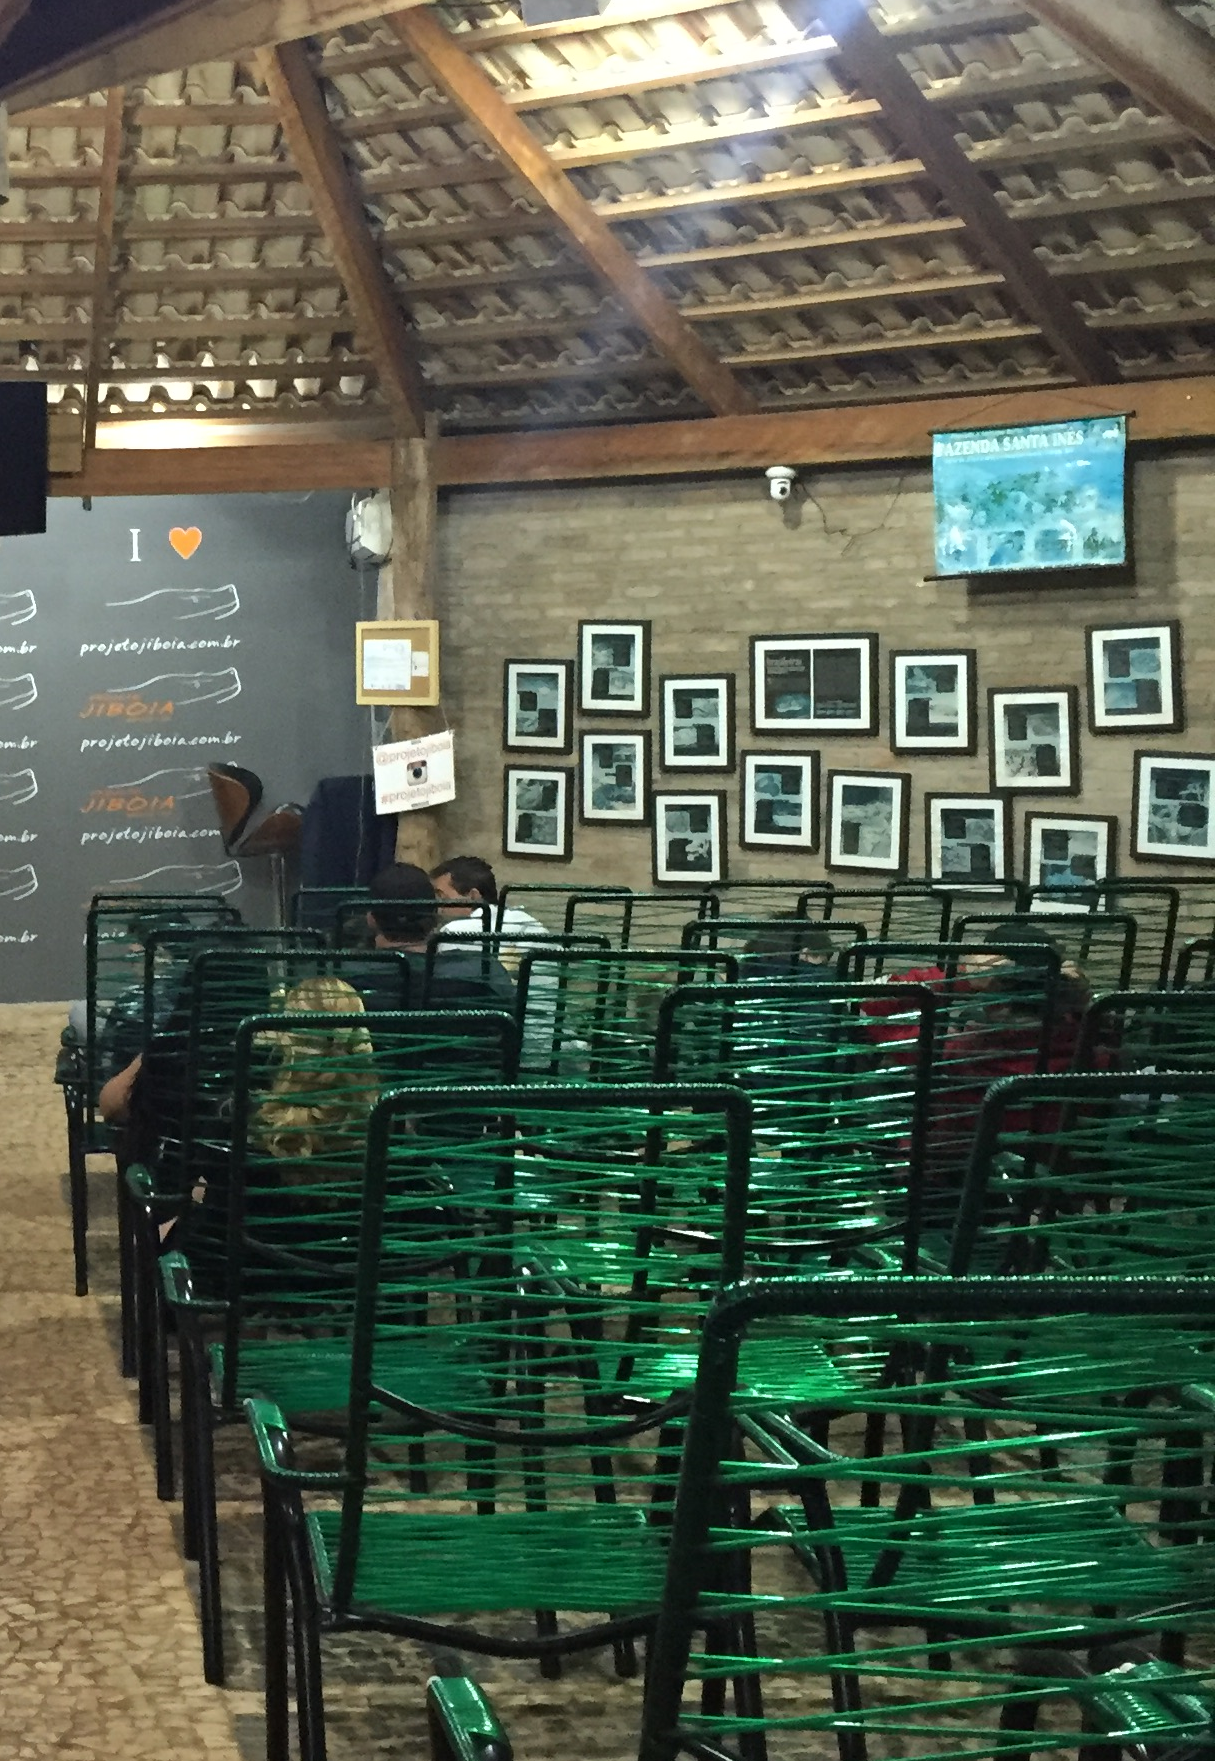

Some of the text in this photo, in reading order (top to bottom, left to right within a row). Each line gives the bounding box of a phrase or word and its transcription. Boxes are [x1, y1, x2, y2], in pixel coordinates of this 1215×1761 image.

[1003, 433, 1049, 452] SANTA
[79, 635, 241, 658] projetojiboia.com.br
[79, 701, 174, 718] JIBOIA
[80, 731, 242, 753] projetojiboia.com.br
[80, 796, 175, 813] JIBOIA
[80, 826, 221, 846] projetojiboia.com
